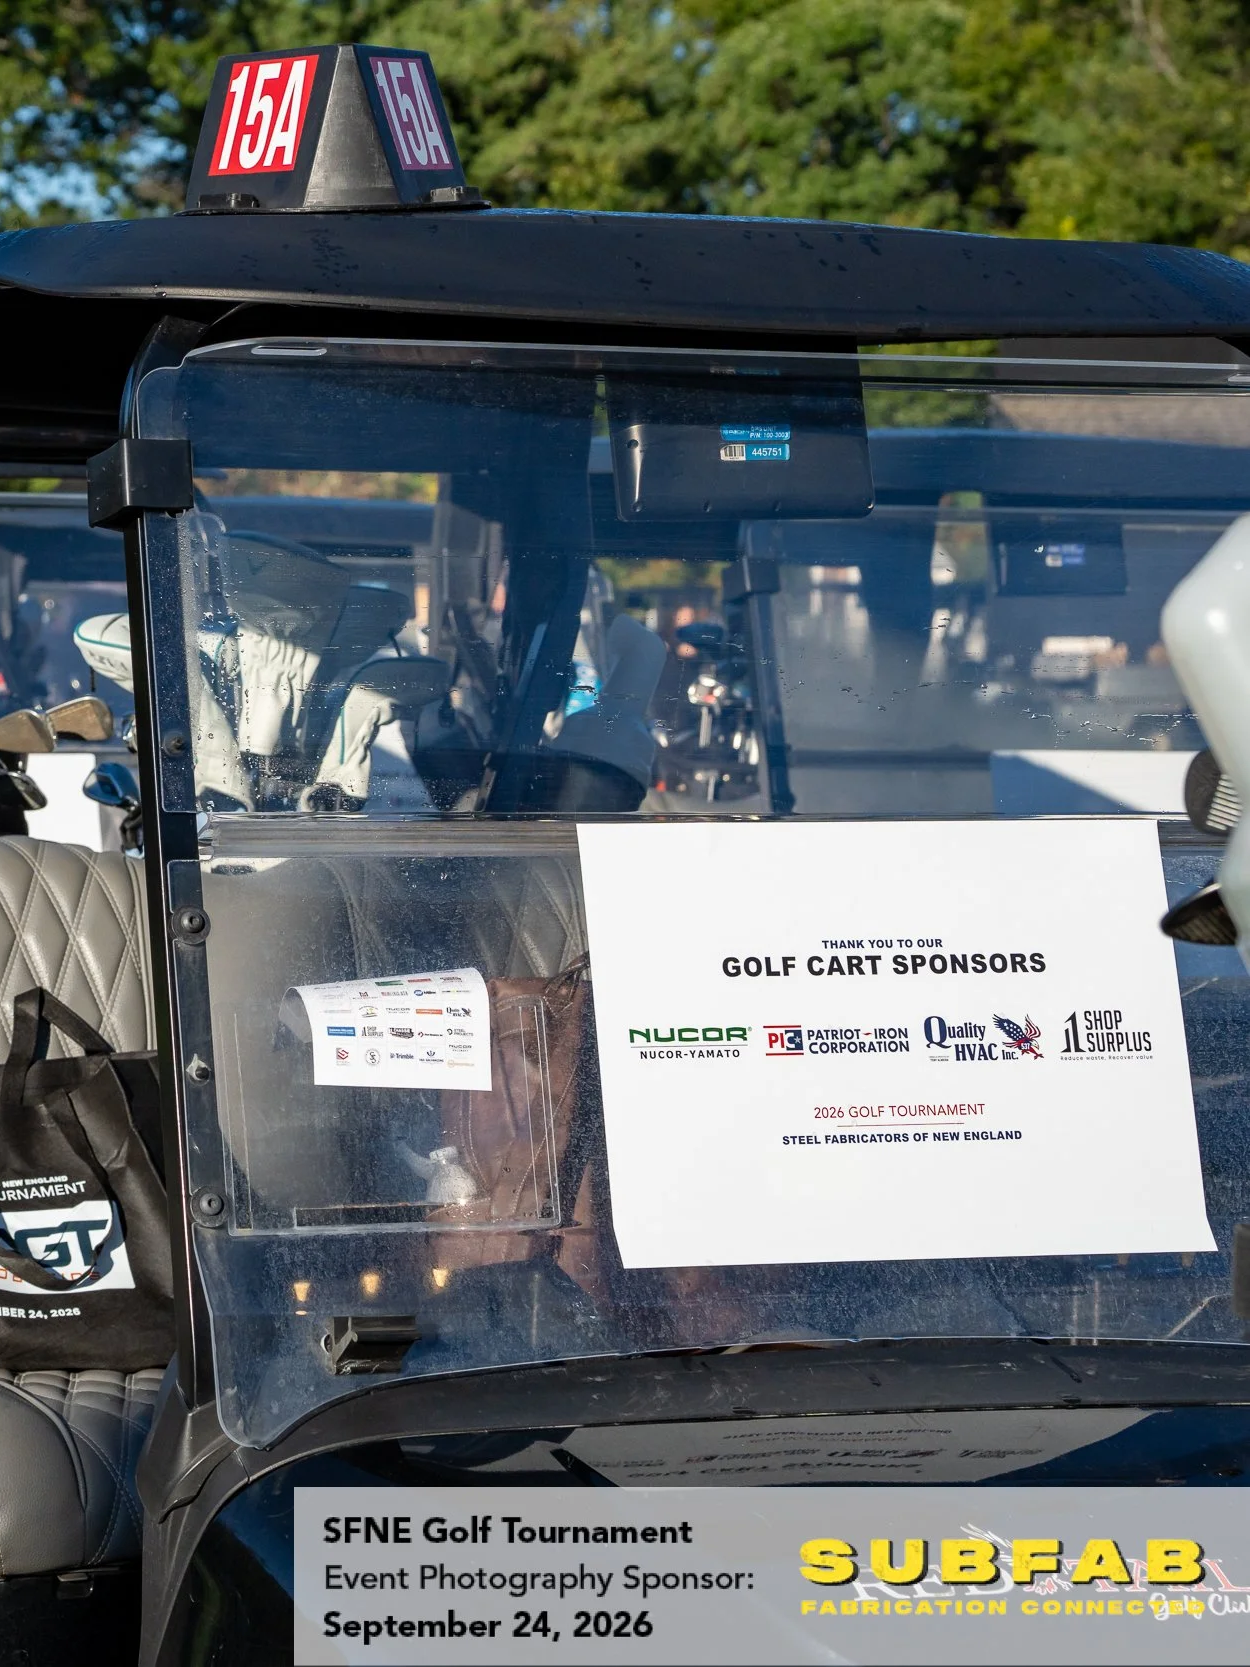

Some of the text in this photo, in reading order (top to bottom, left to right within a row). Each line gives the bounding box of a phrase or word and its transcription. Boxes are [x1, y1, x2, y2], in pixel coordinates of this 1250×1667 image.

[218, 59, 307, 170] 15A
[375, 60, 450, 167] 15A
[752, 447, 782, 457] 445751
[822, 938, 943, 950] THANK YOU TO OUR
[722, 952, 1047, 978] GOLF CART SPONSORS
[1084, 1009, 1123, 1031] SHOP
[628, 1026, 748, 1044] NUCOR
[923, 1015, 987, 1050] Quality
[807, 1040, 910, 1055] CORPORATION
[1086, 1030, 1152, 1053] SURPLUS
[396, 1052, 414, 1060] Trimble
[639, 1048, 741, 1061] NUCOR-YAMATO
[954, 1042, 999, 1062] HVAC
[1002, 1049, 1019, 1061] Inc.
[813, 1103, 986, 1119] 2026 GOLF TOURNAMENT
[782, 1129, 1023, 1146] STEEL FABRICATORS OF NEW ENGLAND
[2, 1180, 24, 1188] NEW
[25, 1175, 69, 1186] ENGLAND
[29, 1309, 49, 1320] 24,
[50, 1306, 81, 1318] 2026
